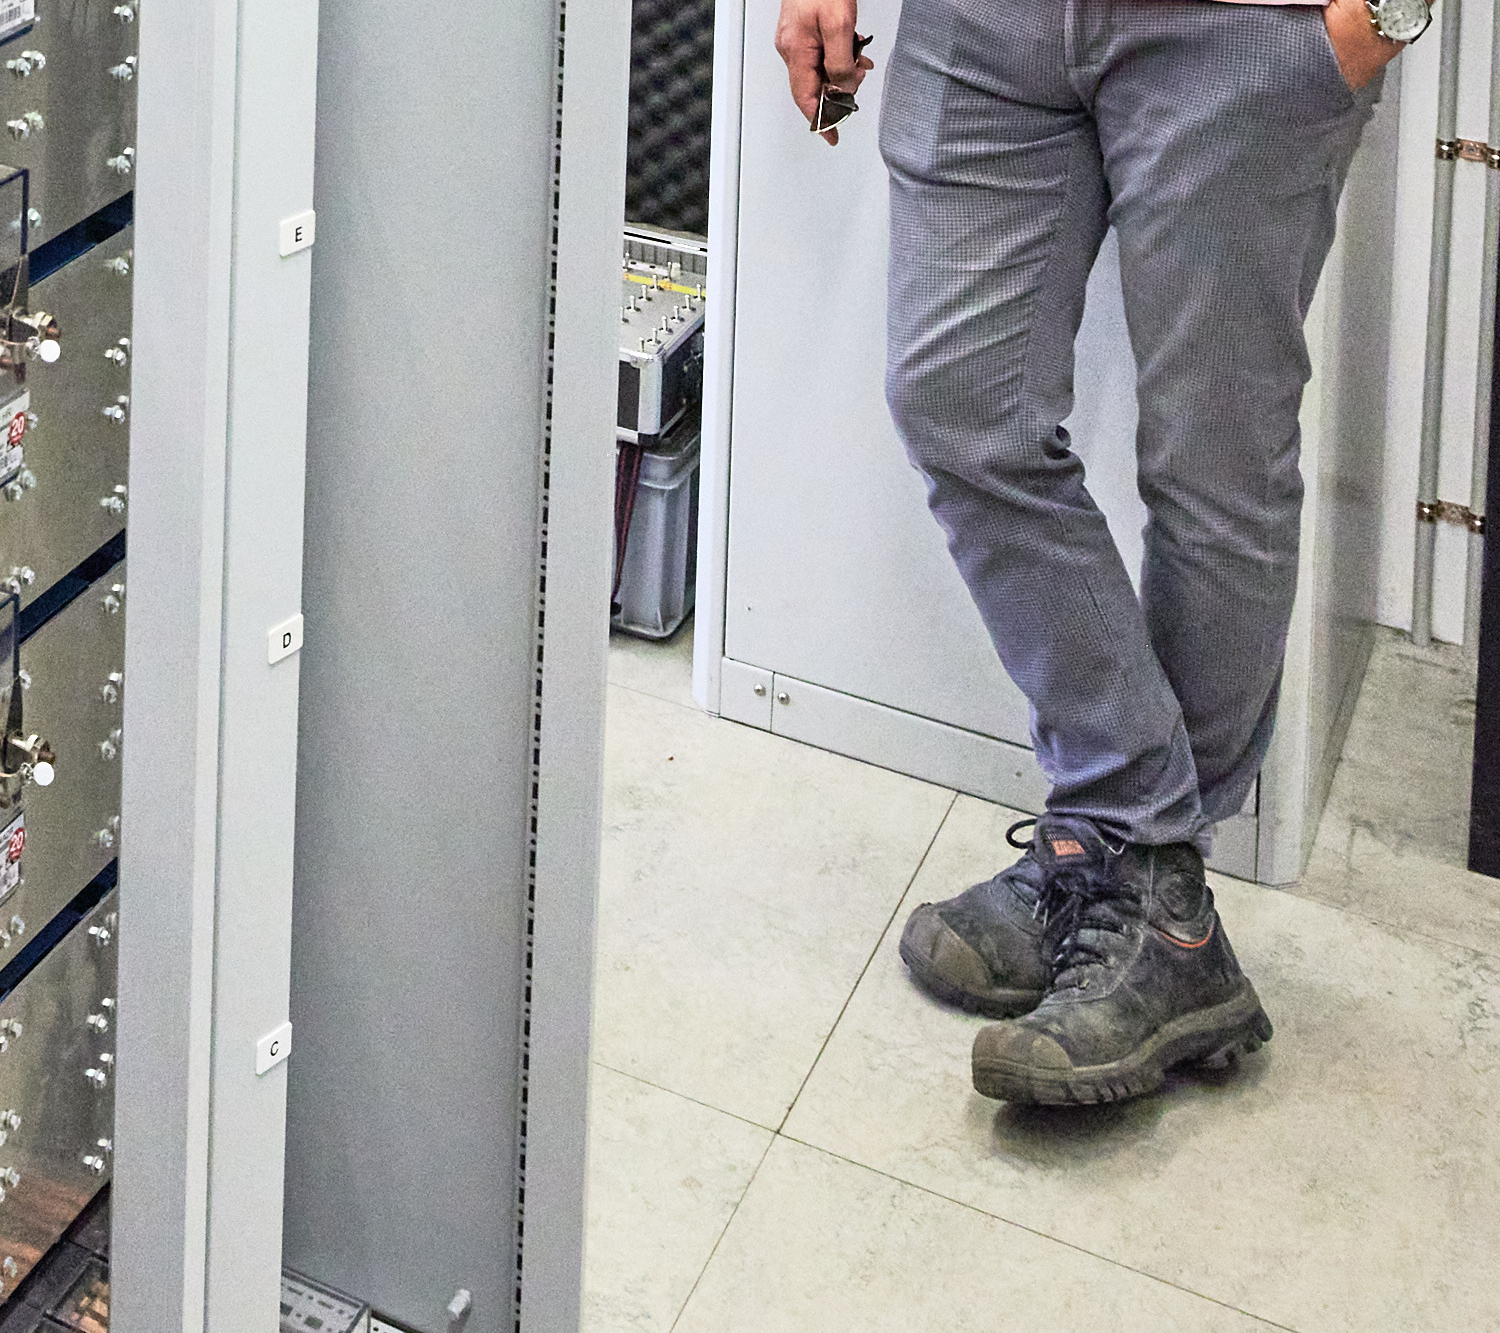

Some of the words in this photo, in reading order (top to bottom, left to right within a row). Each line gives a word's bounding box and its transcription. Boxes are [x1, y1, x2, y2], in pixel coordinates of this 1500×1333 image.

[295, 226, 303, 243] E
[10, 418, 25, 438] 20
[282, 632, 292, 649] D
[9, 833, 24, 853] 20
[270, 1040, 279, 1057] C
